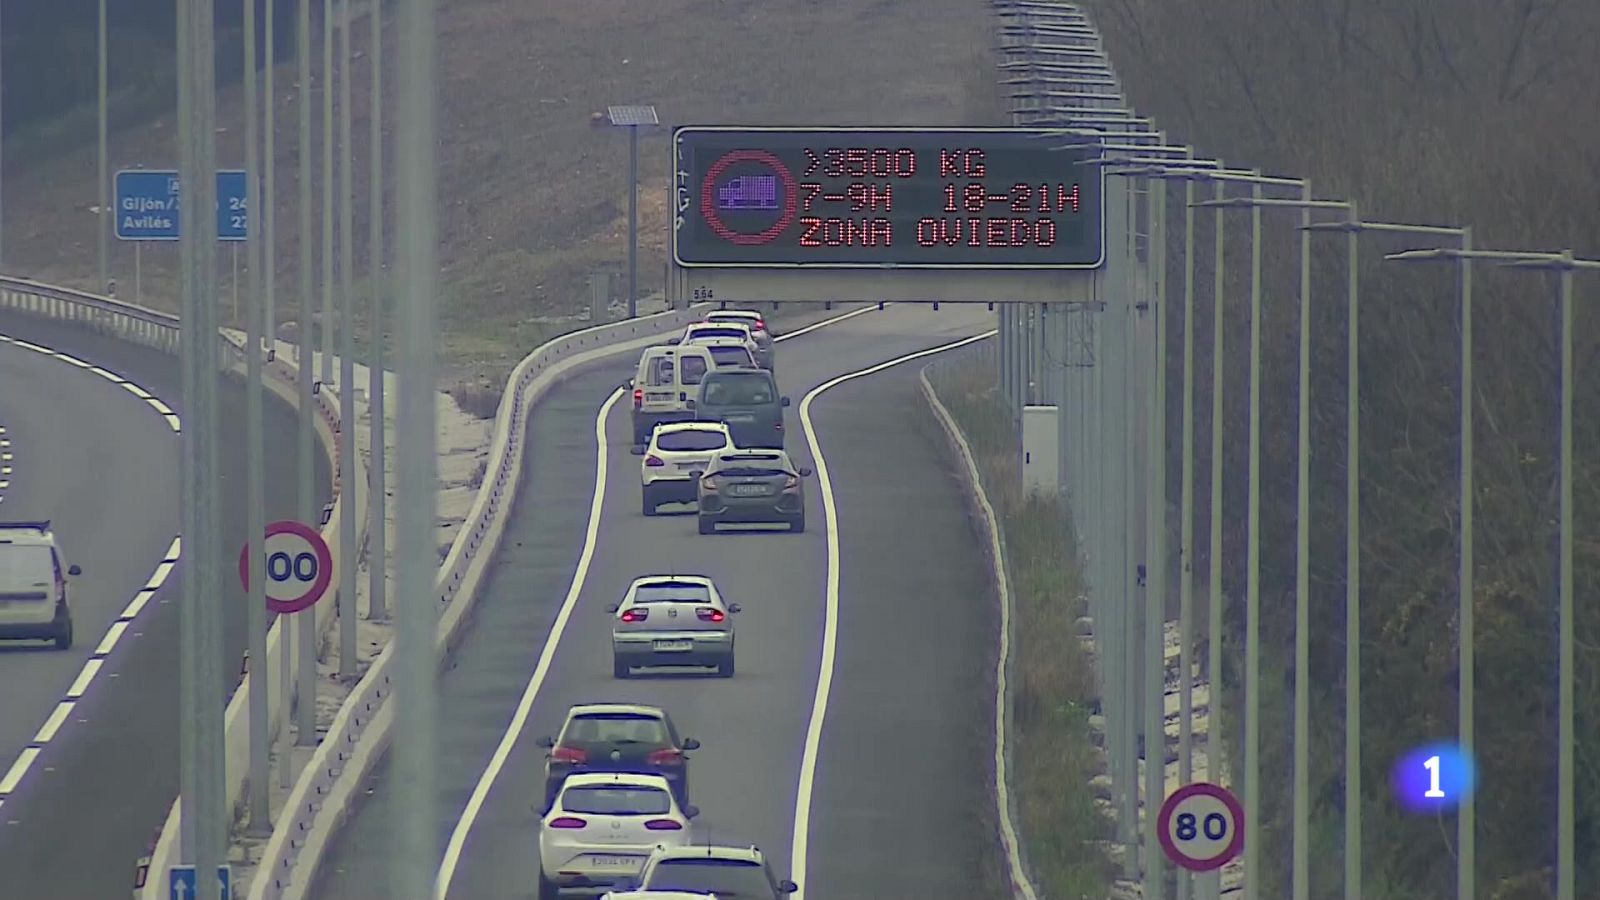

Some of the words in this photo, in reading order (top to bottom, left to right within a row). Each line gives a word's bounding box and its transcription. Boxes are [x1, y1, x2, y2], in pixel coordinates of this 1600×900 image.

[802, 148, 916, 178] >3500
[939, 148, 985, 178] KG
[800, 183, 892, 213] 7-9H
[943, 183, 1080, 213] 18-21H
[123, 215, 172, 229] Avilés
[799, 218, 892, 248] ZONA
[916, 218, 1056, 248] OVIEDO
[264, 551, 318, 582] 00
[1176, 812, 1227, 841] 80
